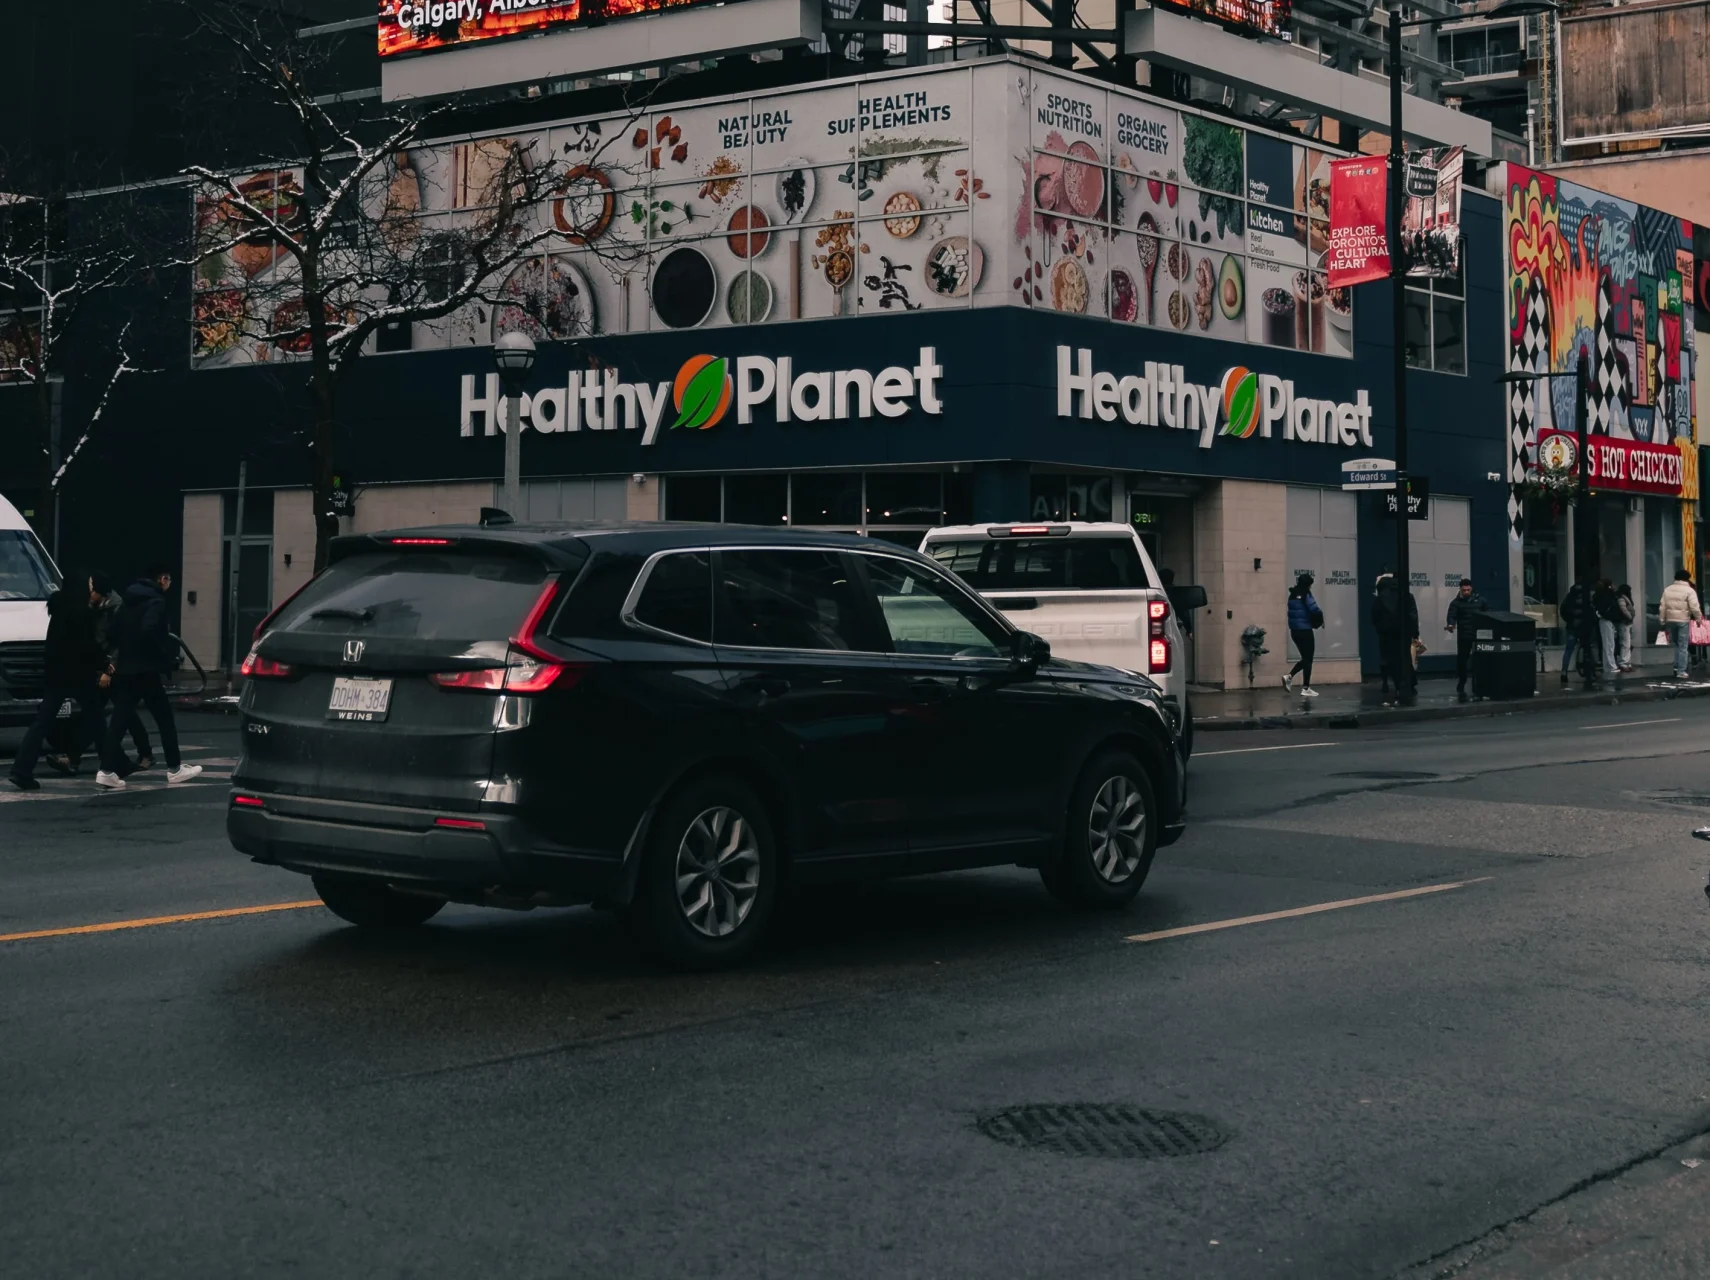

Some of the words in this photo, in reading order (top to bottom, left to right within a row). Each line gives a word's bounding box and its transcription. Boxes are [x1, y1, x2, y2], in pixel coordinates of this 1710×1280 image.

[859, 91, 927, 115] HEALTH
[1047, 93, 1093, 120] SPORTS
[718, 110, 792, 134] NATURAL
[1036, 108, 1102, 138] NUTRITION
[1117, 112, 1168, 139] ORGANIC
[723, 127, 788, 150] BEAUTY
[1117, 129, 1169, 156] GROCERY
[1249, 179, 1269, 195] Healthy
[1250, 209, 1284, 233] Kitchen
[1250, 232, 1263, 243] Real
[1332, 225, 1376, 239] EXPLORE
[1250, 243, 1275, 257] Delicious
[1329, 236, 1386, 250] TORONTO'S
[1335, 246, 1390, 259] CULTURAL
[1250, 259, 1266, 270] Fresh
[1267, 261, 1280, 273] Food
[1330, 258, 1367, 270] HEART
[737, 346, 944, 425] Planet
[1056, 344, 1222, 449] Healthy
[1259, 373, 1373, 448] Planet
[1600, 446, 1626, 480] HOT
[1630, 450, 1683, 486] CHICKEN
[1350, 472, 1379, 482] Edward
[1380, 473, 1387, 481] St
[1389, 503, 1418, 513] Plet
[1325, 578, 1357, 586] SUPPLEMENTS
[1481, 643, 1495, 651] Litter
[365, 689, 388, 710] 384
[338, 712, 373, 721] WEINS
